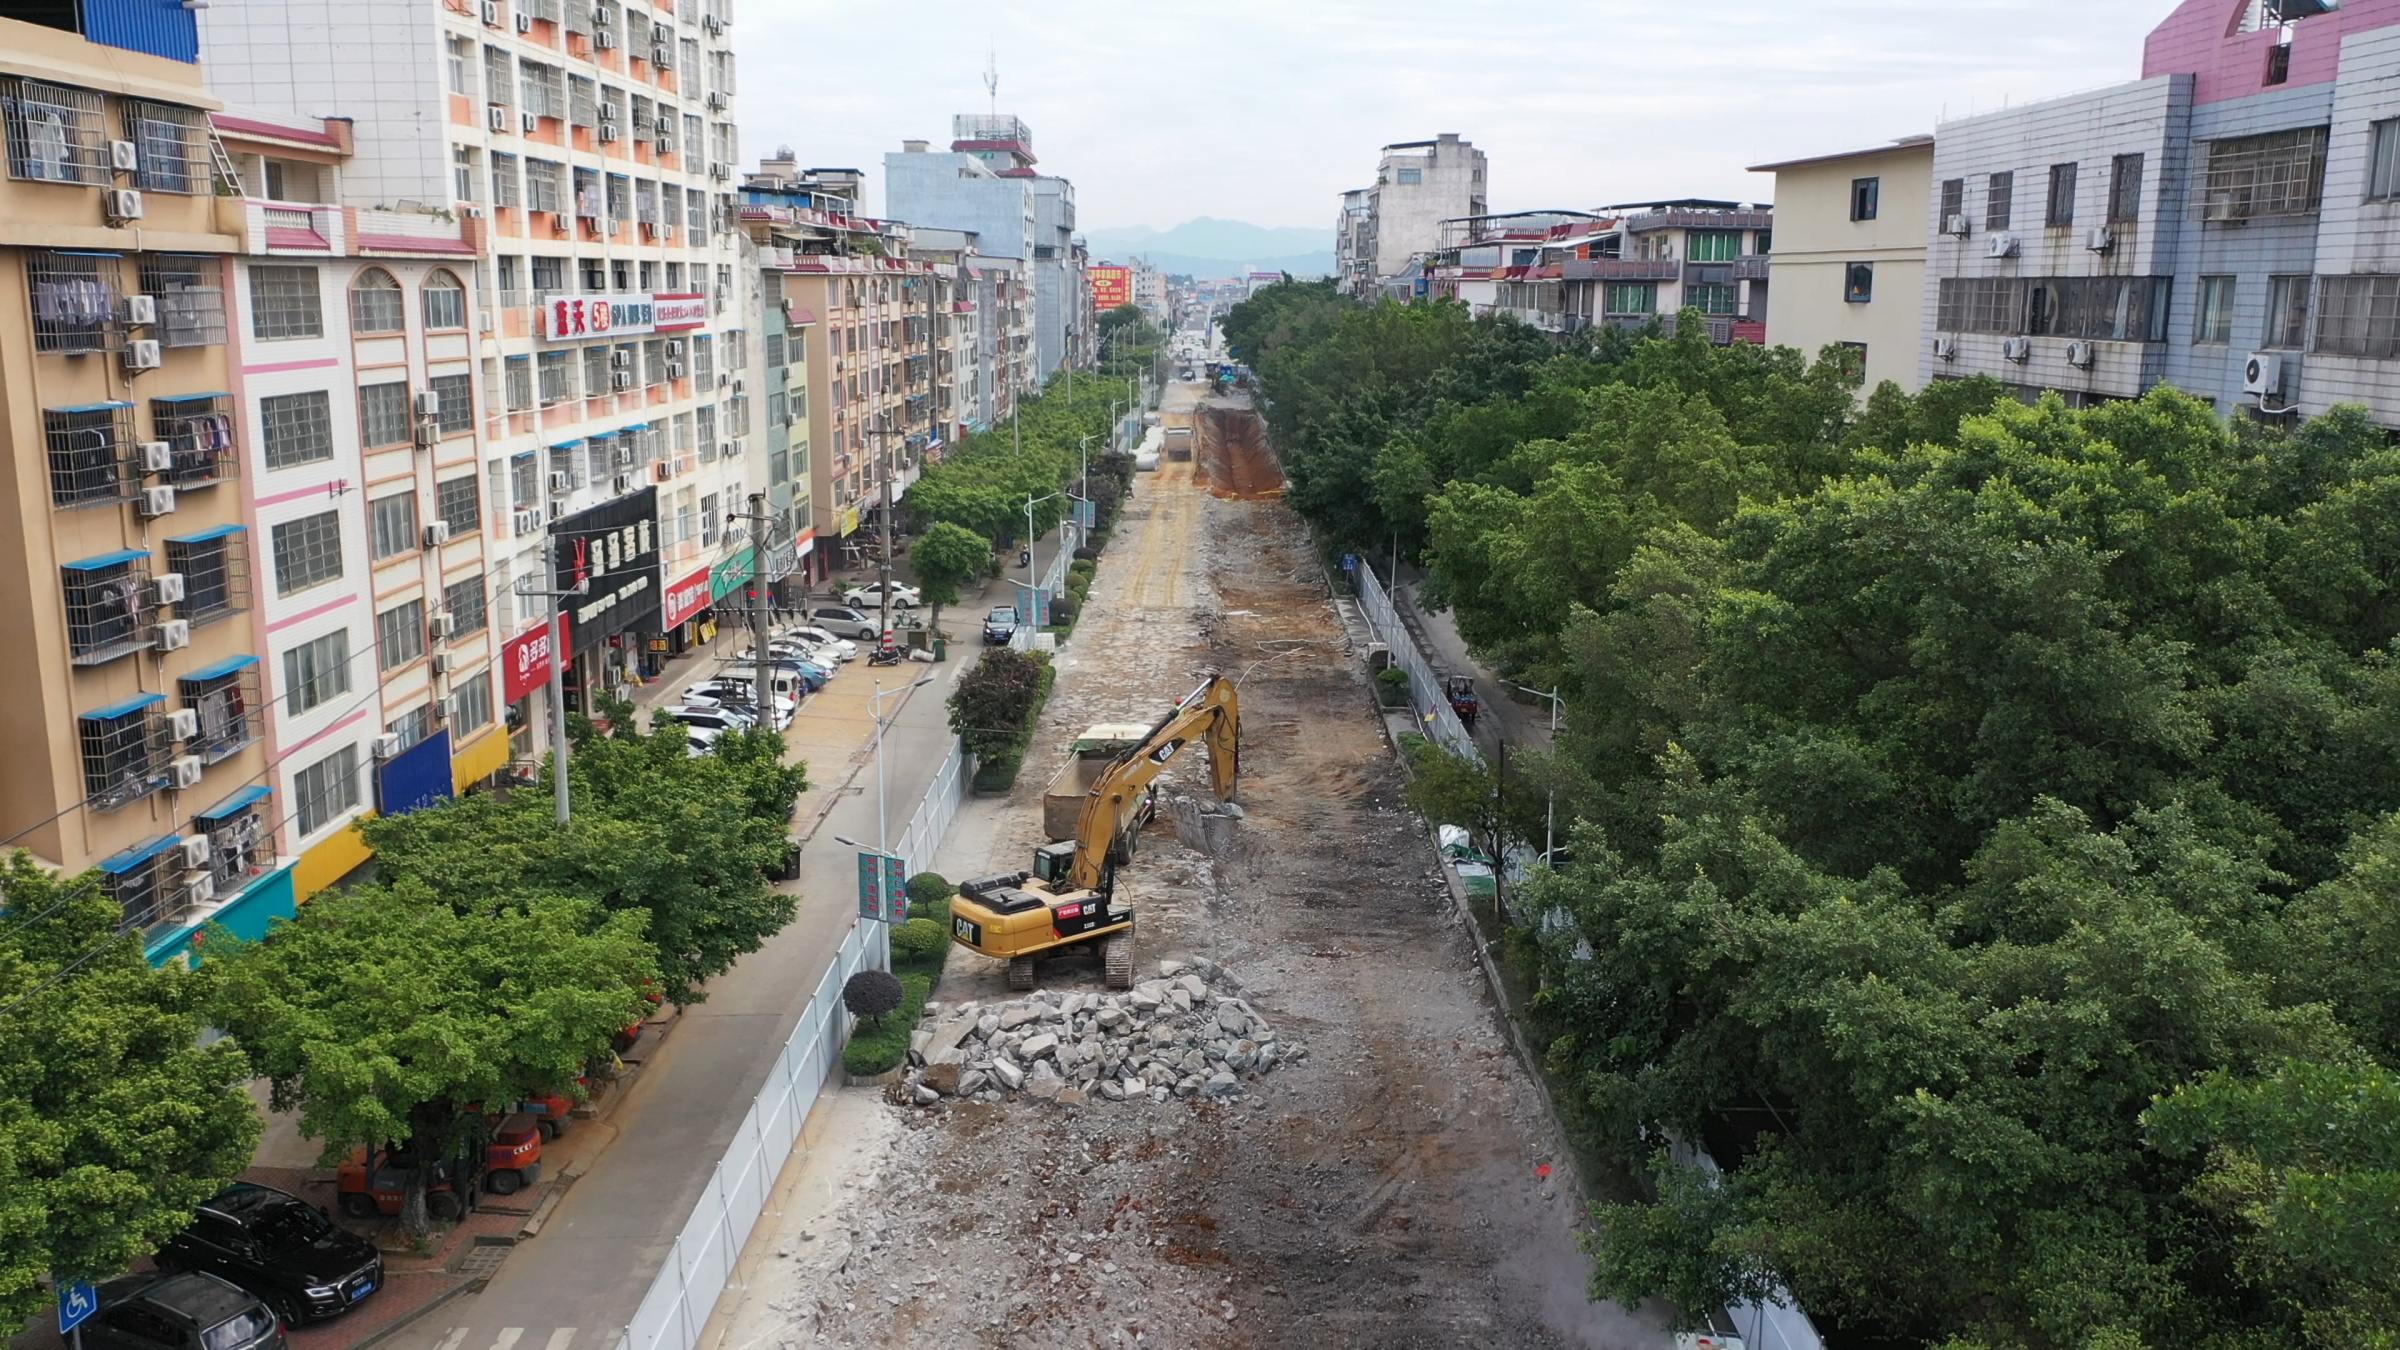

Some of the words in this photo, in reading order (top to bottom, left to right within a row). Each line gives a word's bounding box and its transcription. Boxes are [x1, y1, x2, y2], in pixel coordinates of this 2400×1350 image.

[1157, 741, 1174, 761] CAT
[1083, 903, 1096, 915] CAT
[956, 918, 974, 942] CAT
